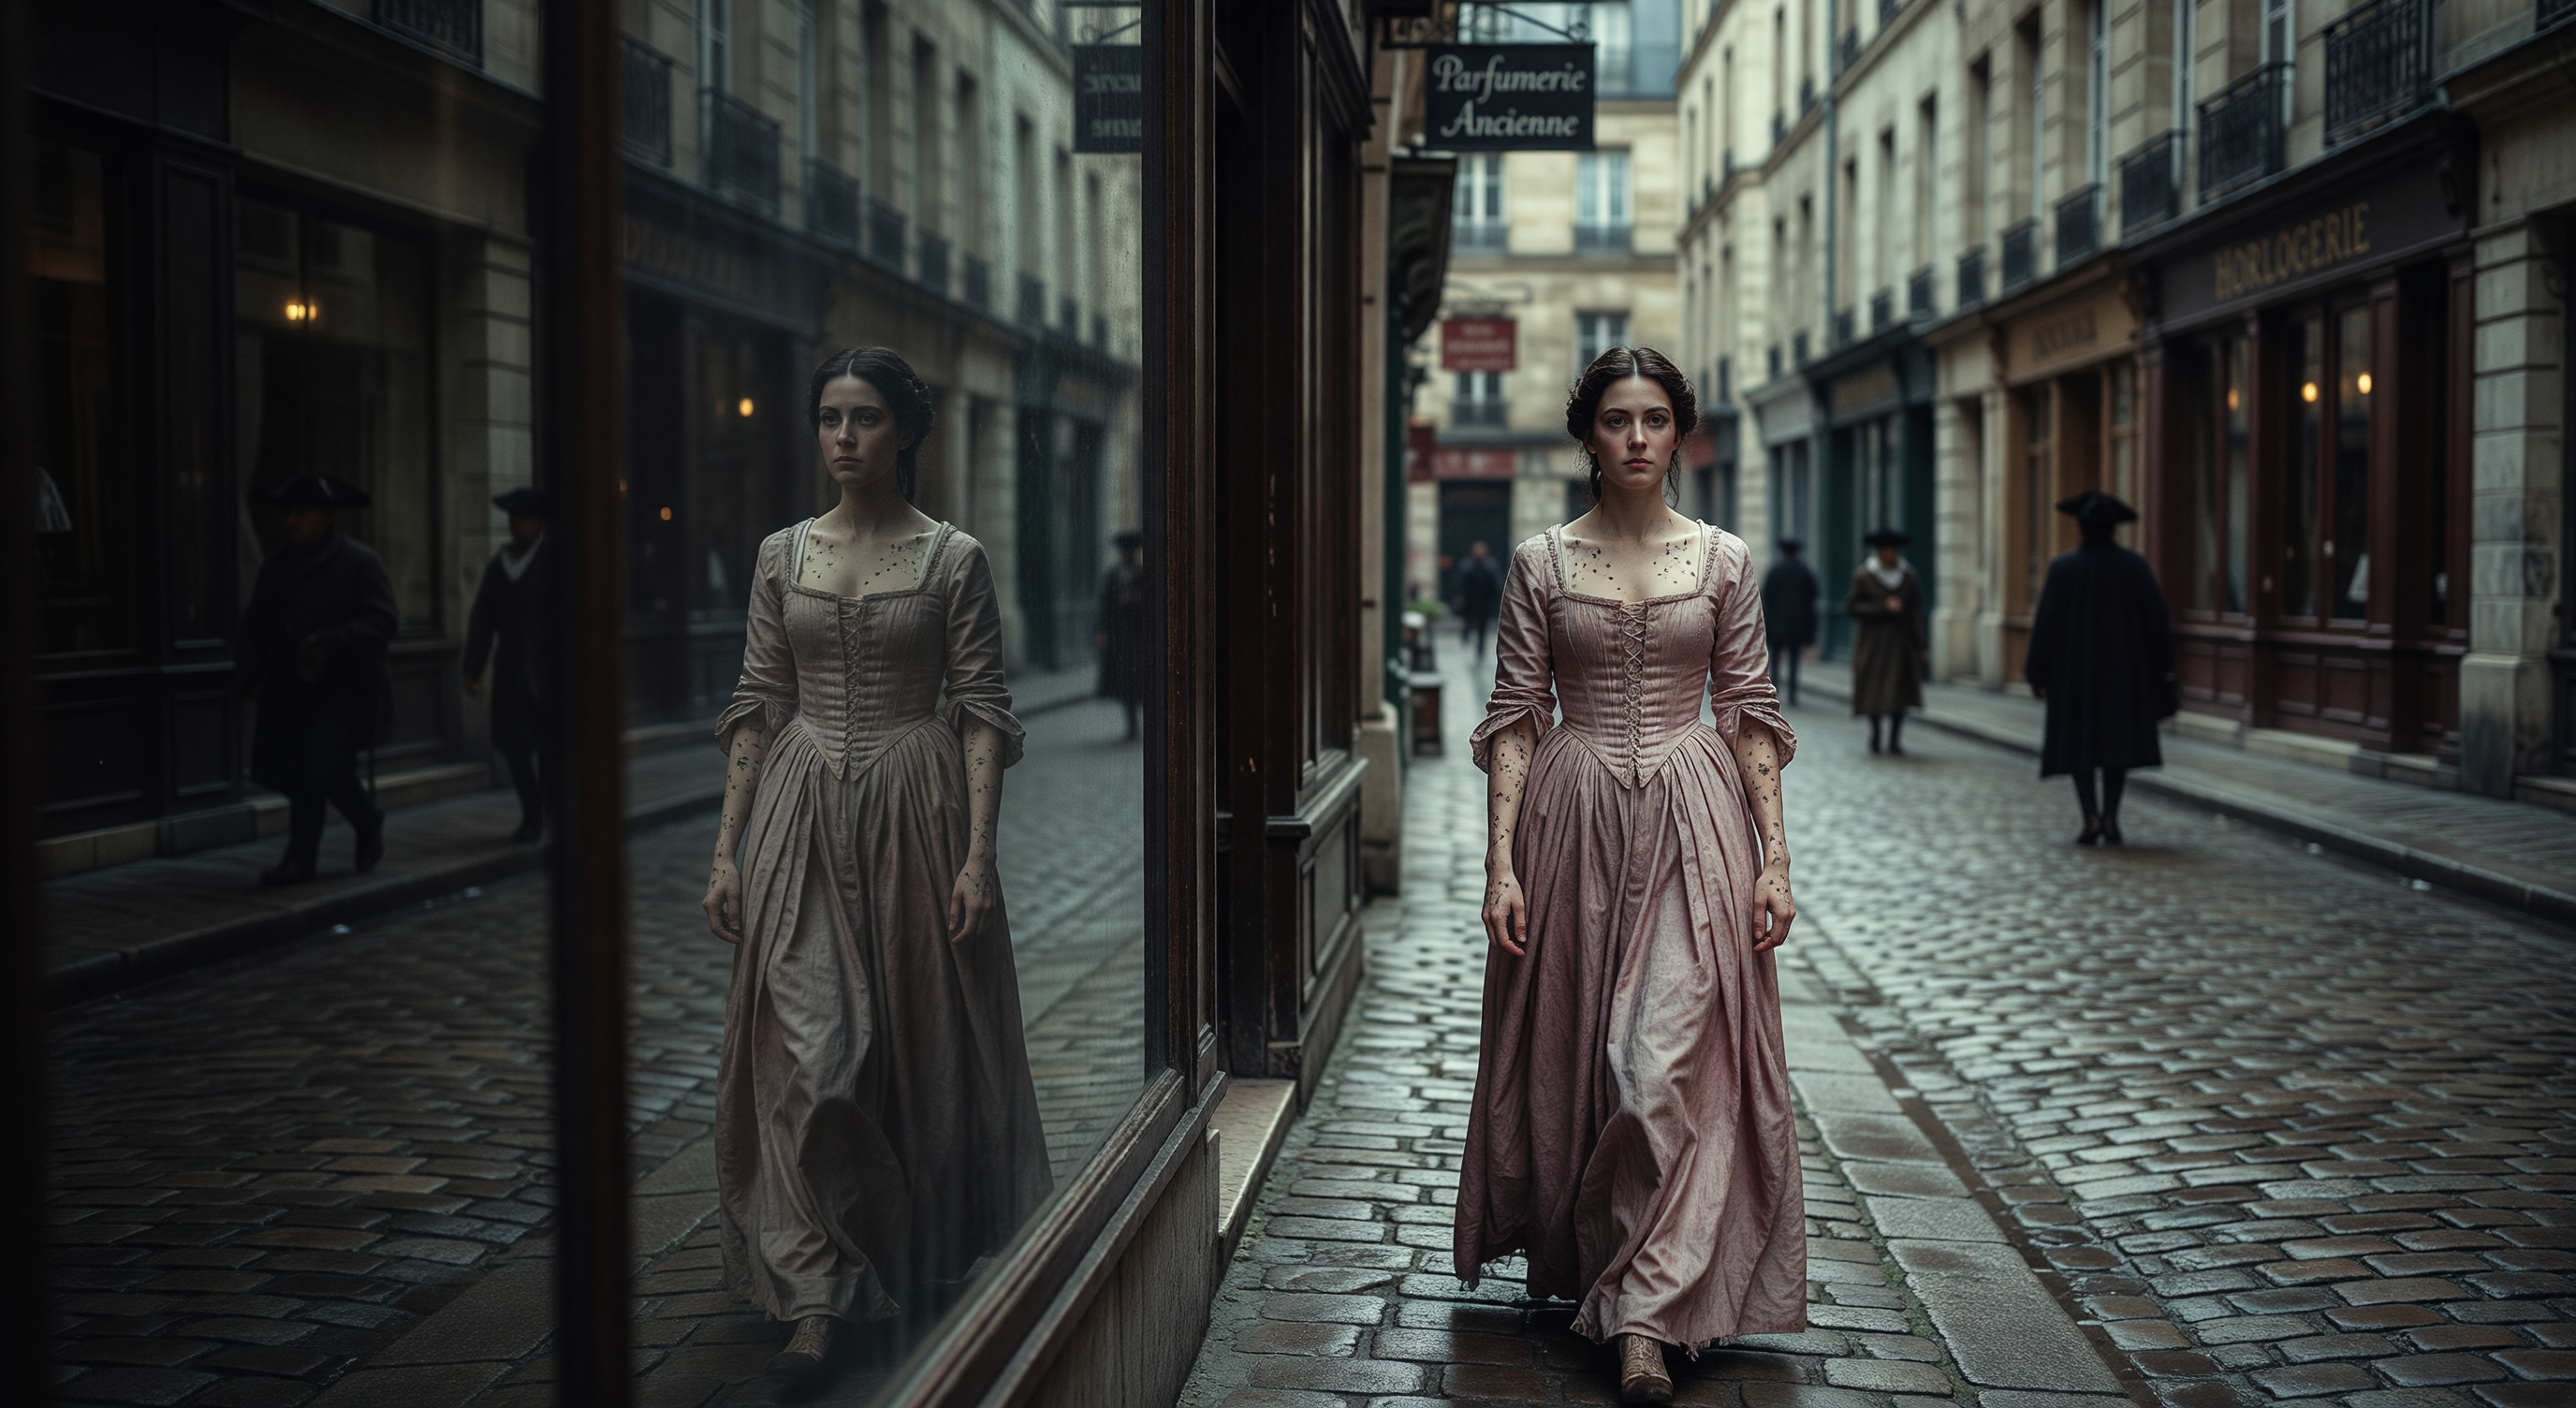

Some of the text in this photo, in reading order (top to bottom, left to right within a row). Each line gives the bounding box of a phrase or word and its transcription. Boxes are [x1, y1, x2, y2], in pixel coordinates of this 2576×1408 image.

[1431, 53, 1588, 105] Parfumerie
[1440, 99, 1580, 138] Ancienne
[2214, 200, 2371, 301] HORLOGERIE
